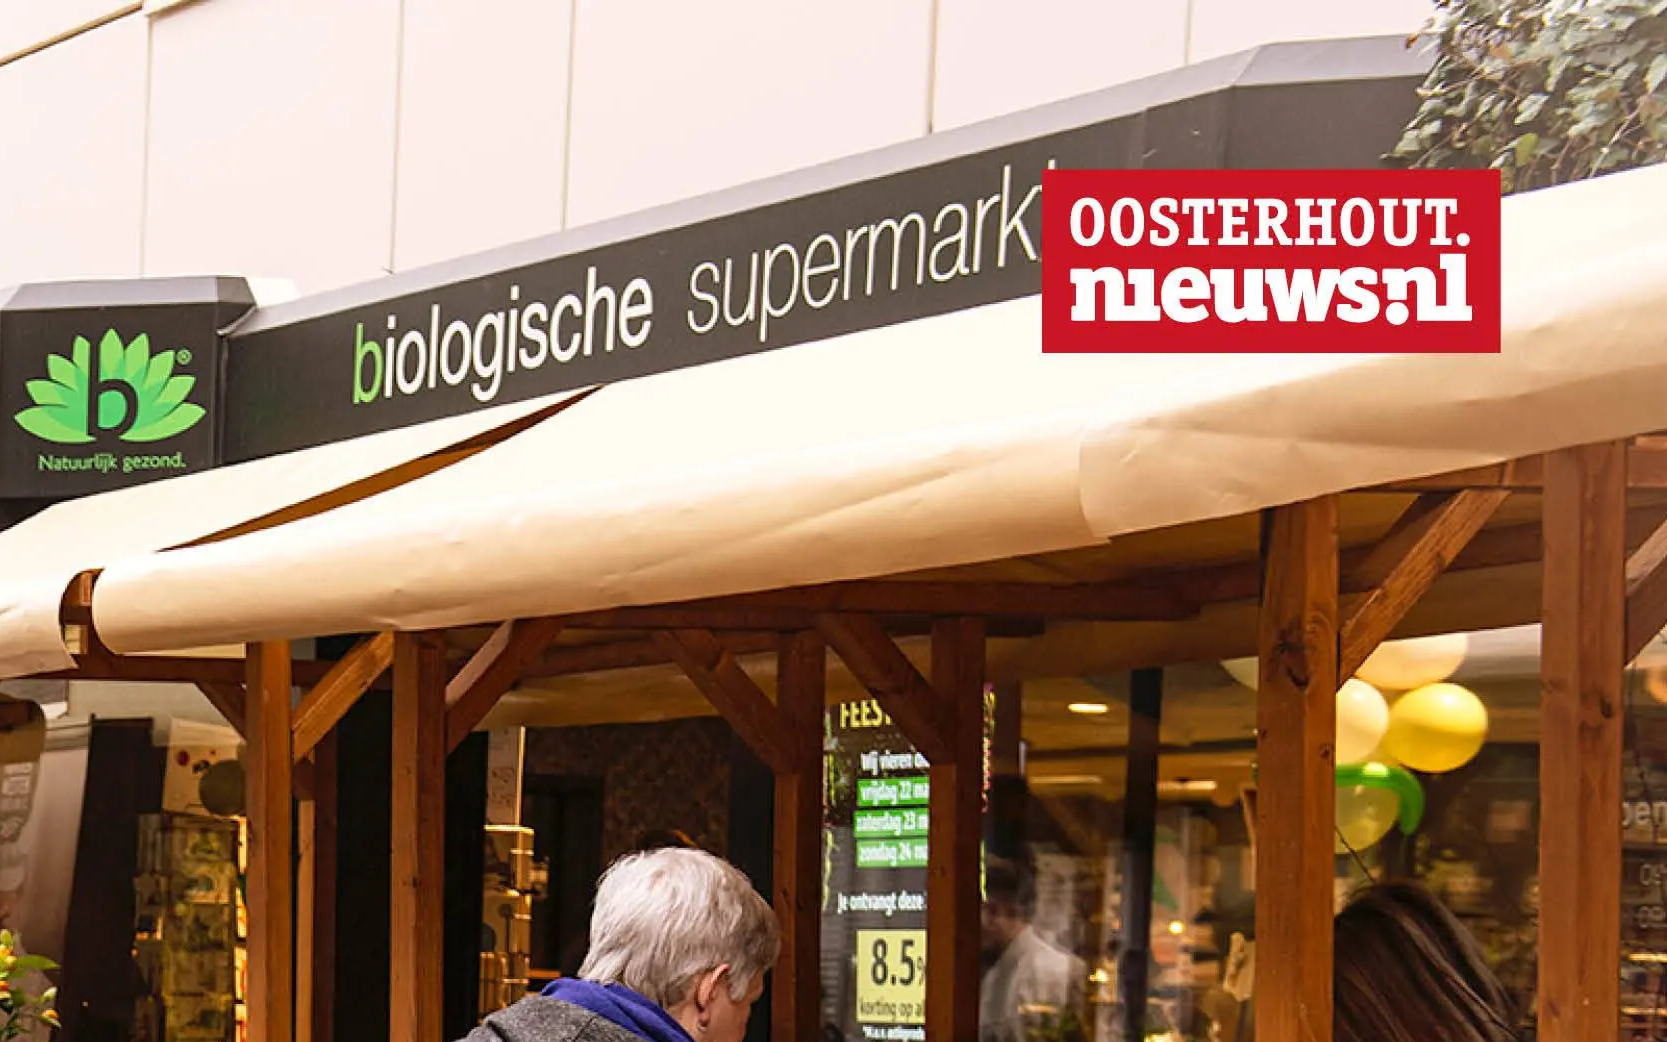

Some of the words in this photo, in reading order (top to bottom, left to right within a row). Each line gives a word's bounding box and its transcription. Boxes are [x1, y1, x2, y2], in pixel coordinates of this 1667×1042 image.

[352, 267, 652, 404] biologische
[687, 160, 1056, 341] supermark
[38, 453, 117, 474] Natuurlijk
[122, 451, 186, 474] gezond.
